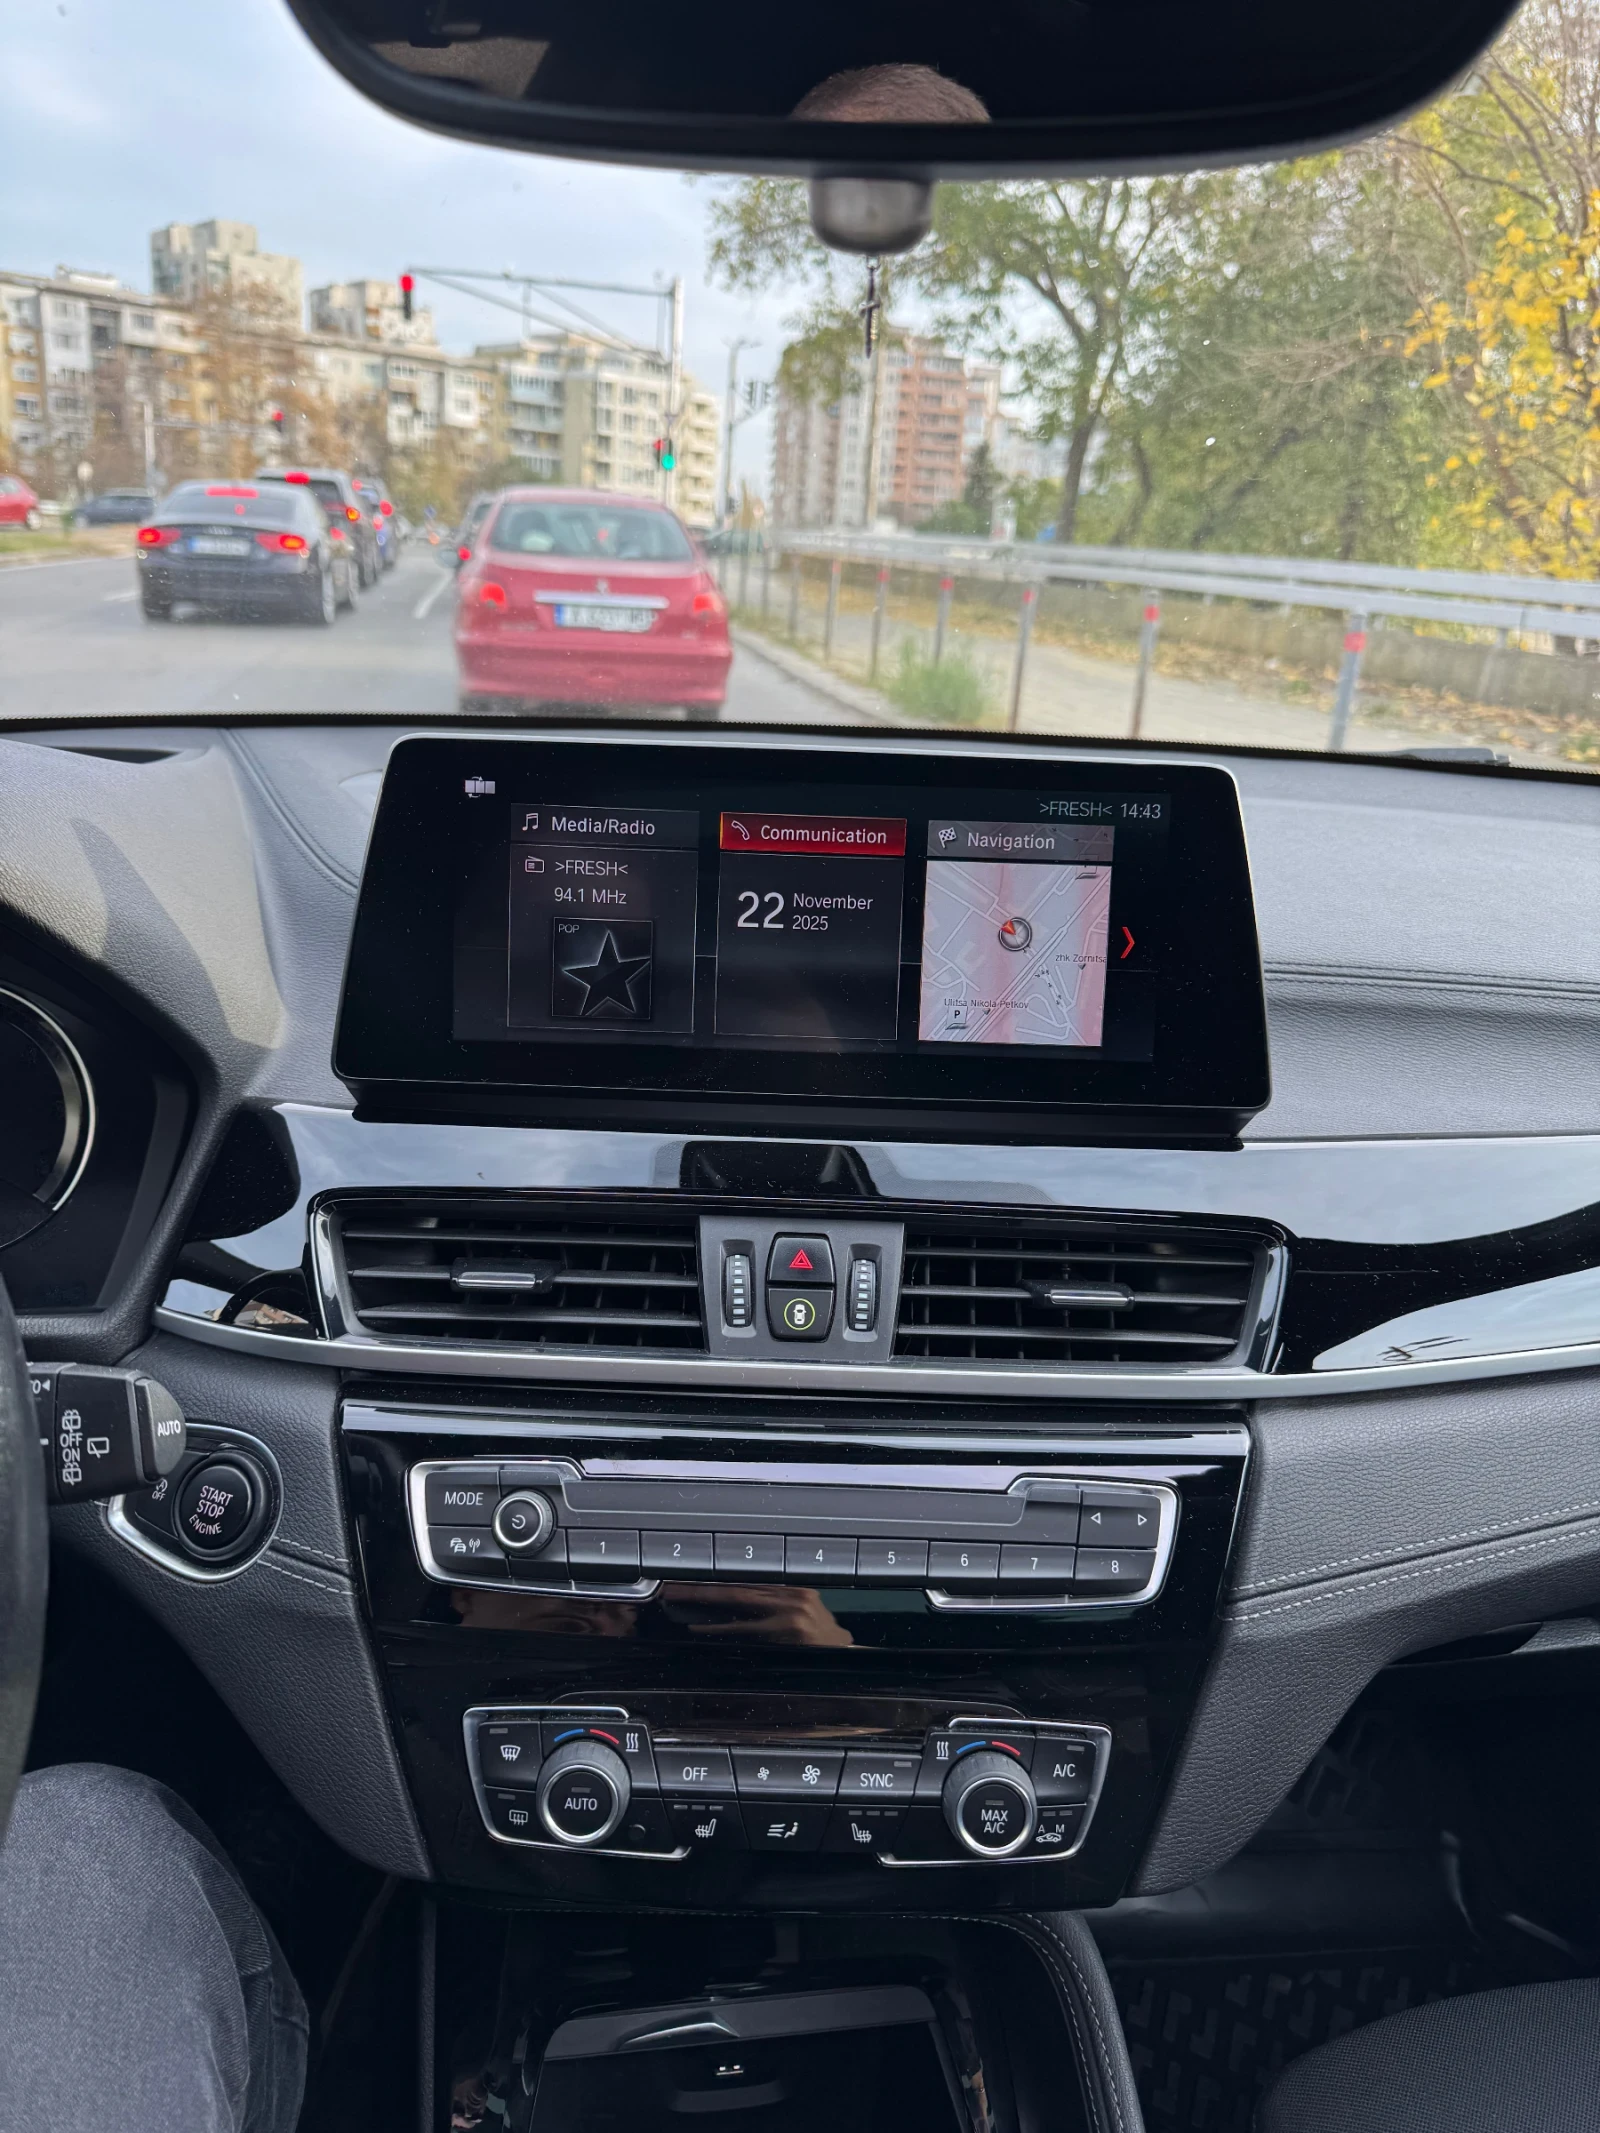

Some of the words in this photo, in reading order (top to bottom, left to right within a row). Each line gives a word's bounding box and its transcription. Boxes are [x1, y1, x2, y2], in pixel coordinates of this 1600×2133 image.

[1039, 801, 1112, 817] >FRESH<
[1121, 803, 1161, 819] 14:43
[551, 816, 656, 836] Media/Radio
[760, 825, 887, 845] Communication
[967, 832, 1056, 851] Navigation
[554, 859, 629, 876] >FRESH<
[554, 887, 585, 903] 94.1
[592, 889, 627, 904] MHz
[793, 893, 873, 910] November
[737, 891, 785, 929] 22
[558, 923, 580, 934] POP
[792, 914, 829, 931] 2025
[970, 999, 996, 1009] Nikola
[1000, 1000, 1029, 1010] Petkov
[157, 1419, 181, 1437] AUTO
[59, 1432, 82, 1447] OFF
[62, 1449, 80, 1461] ON
[151, 1490, 166, 1501] OFF
[200, 1485, 233, 1506] START
[444, 1491, 484, 1506] MODE
[196, 1499, 225, 1519] STOP
[188, 1513, 222, 1535] ENGINE
[599, 1541, 606, 1554] 1
[673, 1543, 681, 1557] 2
[745, 1546, 753, 1559] 3
[815, 1549, 824, 1563] 4
[887, 1551, 895, 1565] 5
[960, 1553, 969, 1567] 6
[1031, 1557, 1039, 1570] 7
[1111, 1560, 1120, 1574] 8
[682, 1767, 708, 1781] OFF
[1053, 1763, 1076, 1778] A/C
[860, 1773, 894, 1788] SYNC
[564, 1797, 597, 1811] AUTO
[980, 1809, 1008, 1822] MAX
[983, 1822, 1005, 1834] A/C
